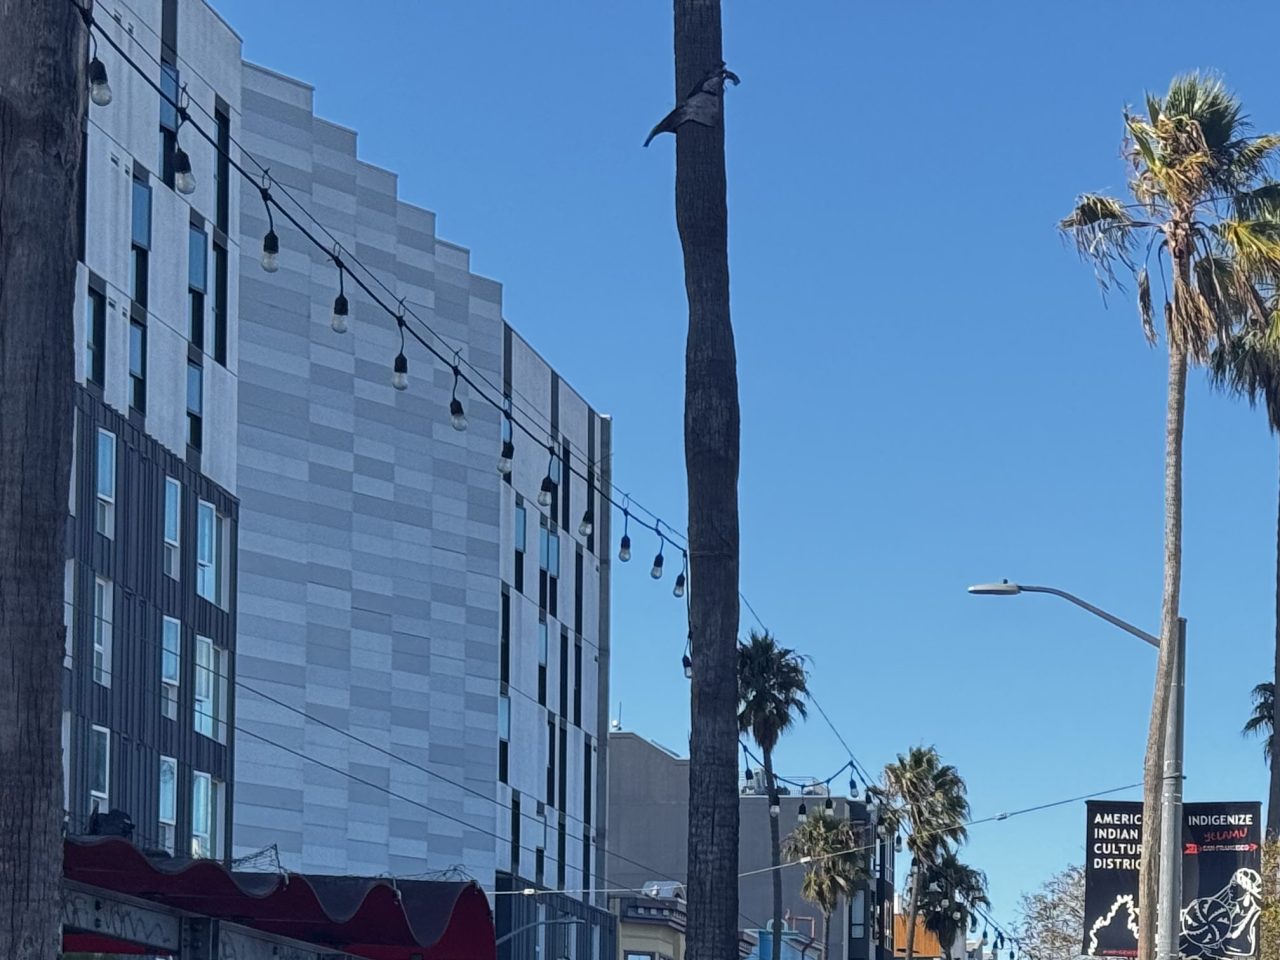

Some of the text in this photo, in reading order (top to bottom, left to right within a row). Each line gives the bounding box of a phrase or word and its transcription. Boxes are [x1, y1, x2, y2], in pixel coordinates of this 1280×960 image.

[1094, 813, 1142, 824] AMERIC
[1188, 814, 1253, 826] INDIGENIZE
[1094, 828, 1139, 839] INDIAN
[1094, 843, 1143, 855] CULTUR
[1093, 858, 1142, 870] DISTRIC
